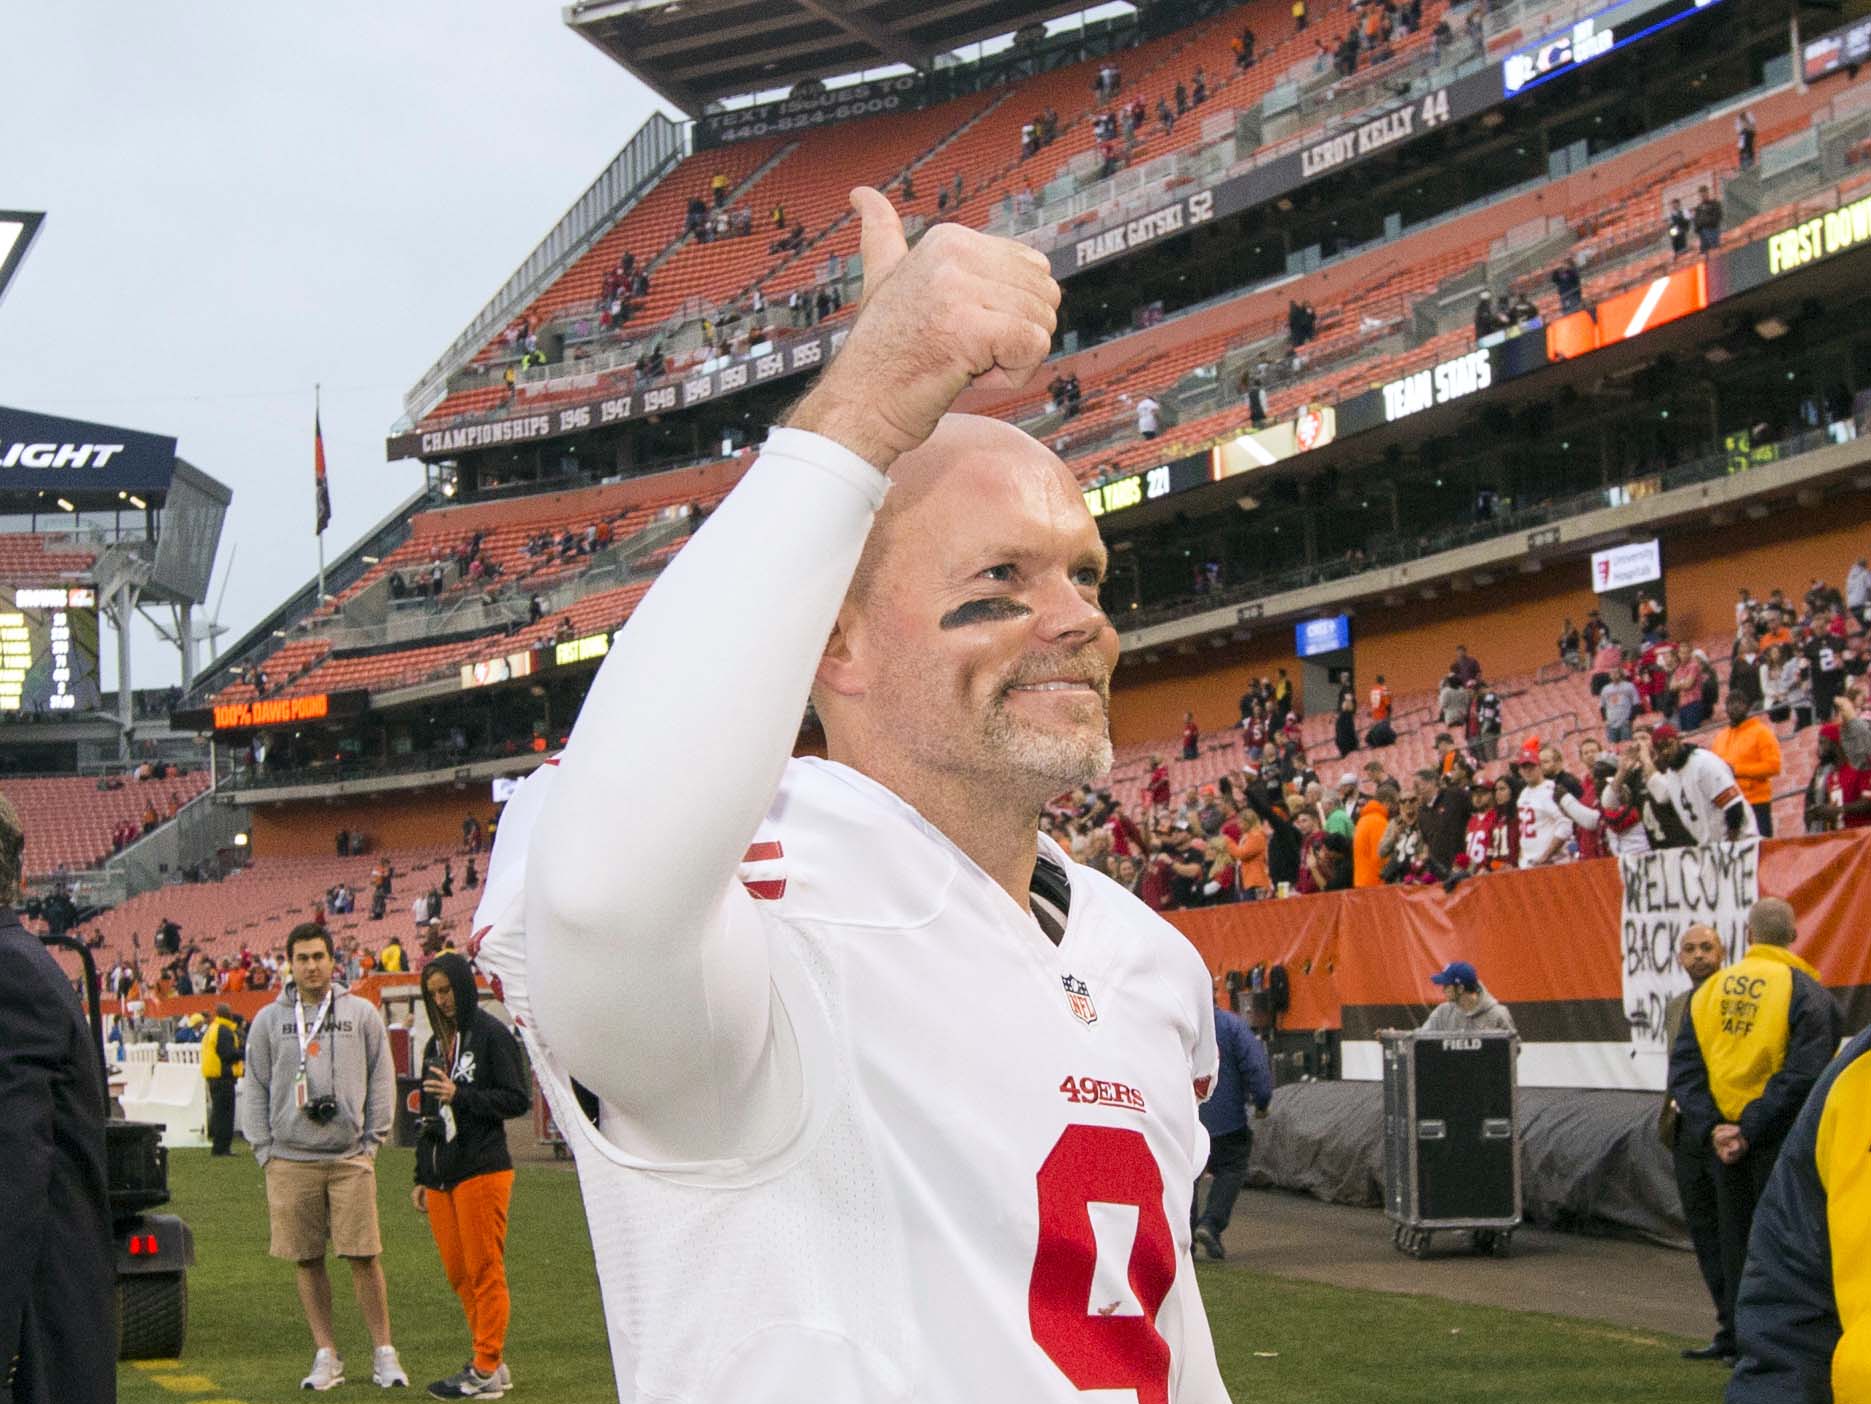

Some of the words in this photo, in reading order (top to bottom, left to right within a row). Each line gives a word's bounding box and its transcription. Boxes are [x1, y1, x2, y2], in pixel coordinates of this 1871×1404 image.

[709, 106, 769, 130] TEXT
[879, 77, 914, 93] TO
[1301, 130, 1357, 177] LEROY
[1357, 105, 1415, 154] KELLY
[1421, 88, 1449, 127] 44
[1075, 225, 1127, 267] FRANK
[1126, 203, 1184, 248] GATSKI
[1188, 190, 1214, 225] 52
[1768, 218, 1824, 275] FIRST
[1382, 369, 1434, 422] TEAM
[1434, 348, 1491, 403] STATS
[421, 415, 550, 453] CHAMPIONSHIPS
[600, 395, 632, 423] 1947
[0, 443, 124, 468] IGHT
[213, 703, 252, 729] 100%
[251, 699, 291, 726] DAWG
[290, 693, 329, 721] POUND
[1622, 842, 1756, 913] WELCOME
[1069, 993, 1096, 1019] NFL
[1722, 975, 1766, 999] CSC
[1442, 1038, 1483, 1051] FIELD
[1059, 1075, 1146, 1108] 49ERS
